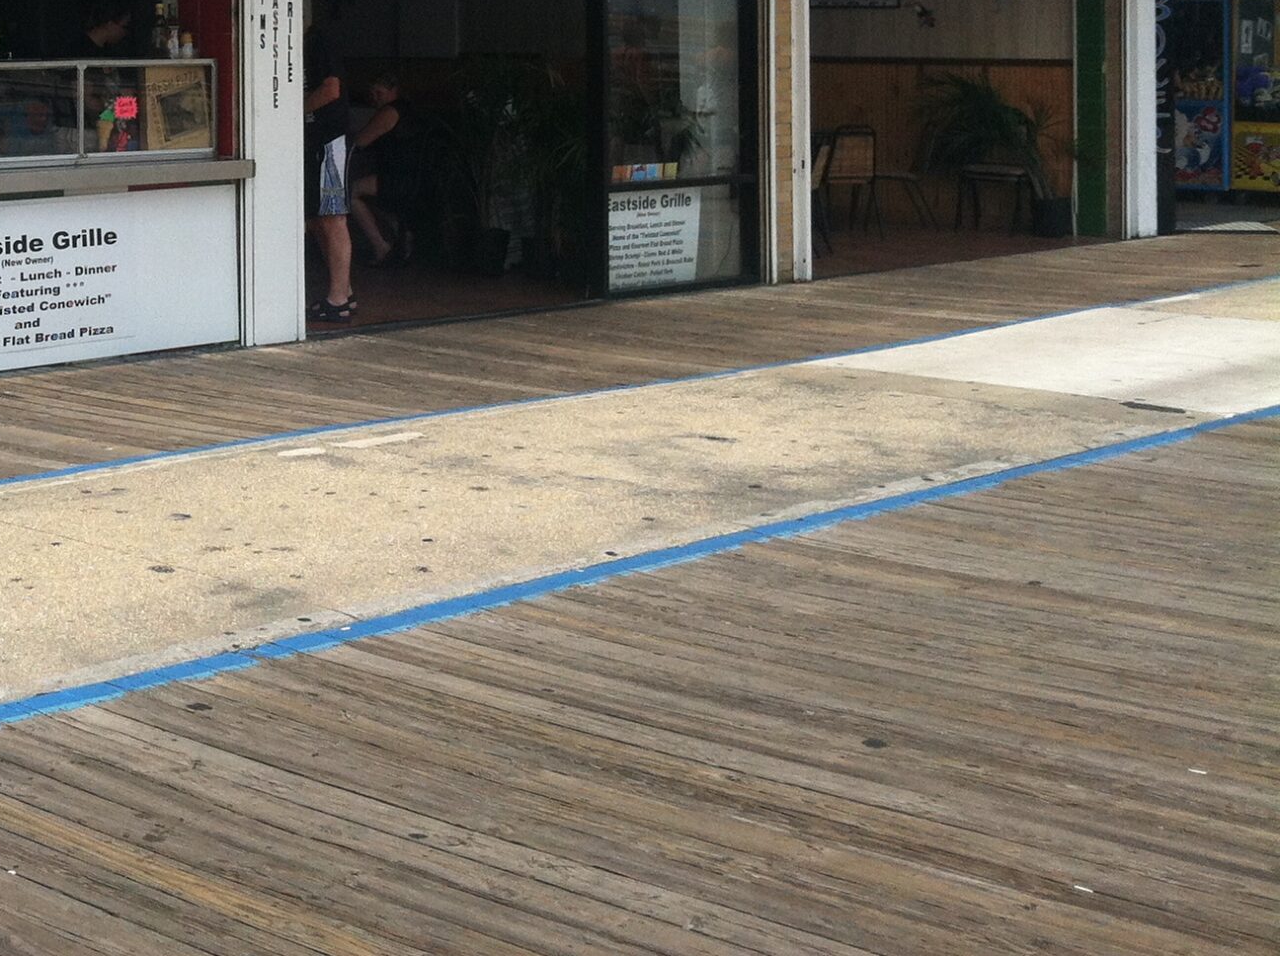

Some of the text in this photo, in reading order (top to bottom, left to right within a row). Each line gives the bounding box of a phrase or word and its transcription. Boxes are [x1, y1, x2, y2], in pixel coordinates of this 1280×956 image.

[660, 192, 692, 209] Grille
[52, 228, 118, 250] Grille
[1, 256, 54, 269] (New Owner)
[20, 268, 62, 283] Lunch
[74, 263, 118, 277] Dinner
[14, 318, 41, 330] and
[2, 333, 31, 347] Flat
[35, 328, 75, 344] Bread
[79, 324, 115, 338] Pizza
